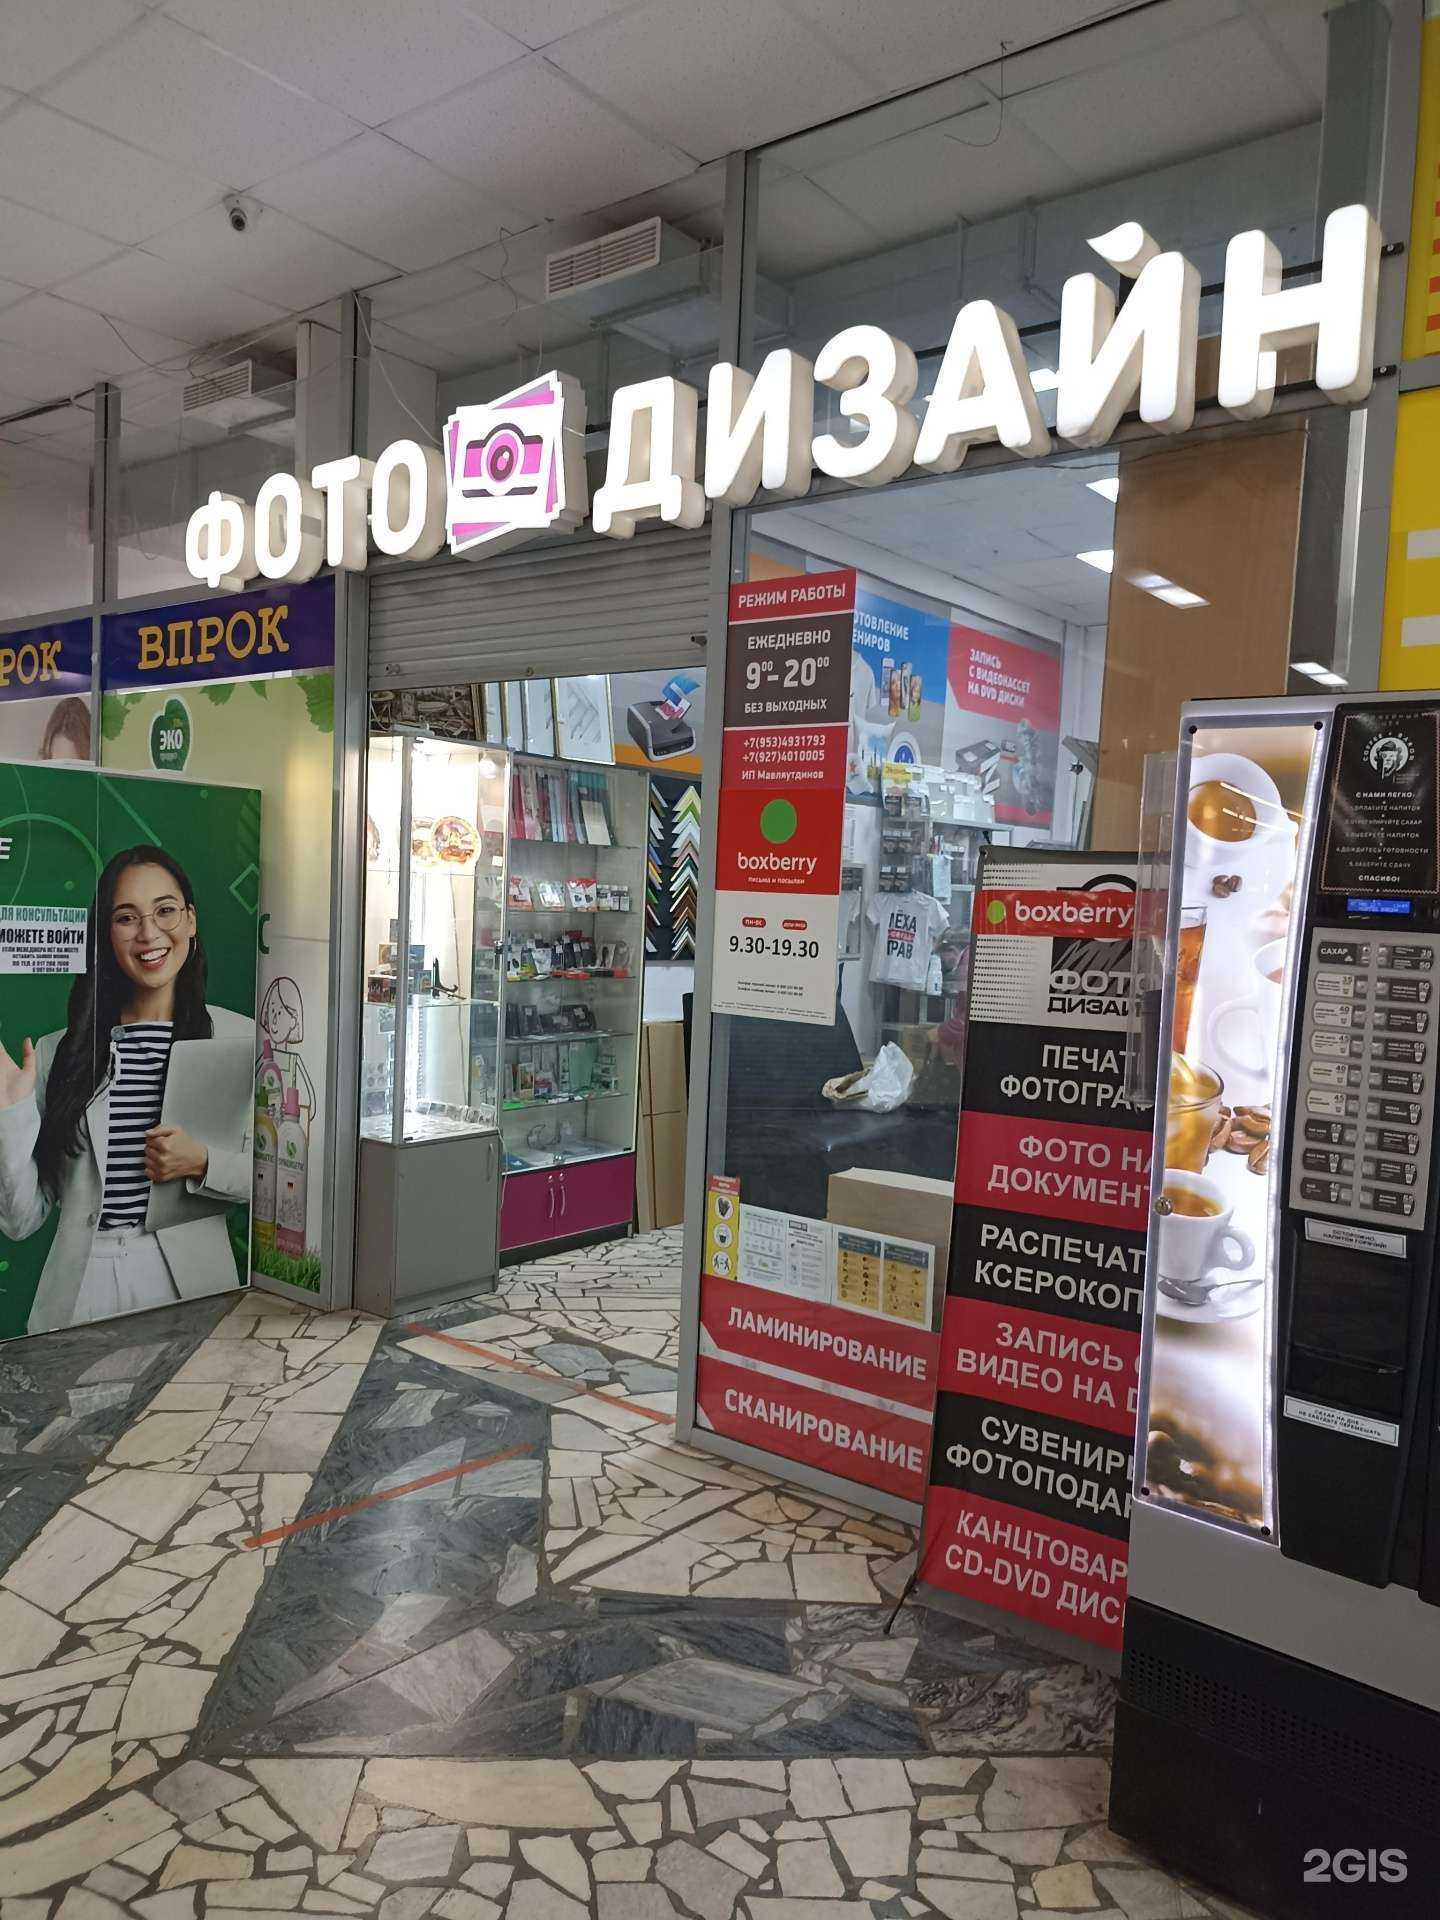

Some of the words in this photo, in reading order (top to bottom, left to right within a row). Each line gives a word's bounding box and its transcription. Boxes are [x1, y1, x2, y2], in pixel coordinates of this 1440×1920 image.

[185, 438, 432, 588] ФОТО
[592, 203, 1376, 536] ДИЗАЙН
[738, 591, 787, 608] РЕЖИМ
[791, 584, 846, 601] РАБОТЫ
[137, 604, 290, 670] ВПРОК
[747, 630, 831, 650] ЕЖЕДНЕВНО
[970, 648, 1002, 669] ЗАПИСЬ
[969, 666, 975, 677] С
[976, 667, 1031, 694] ВИДЕОКАССЕТ
[745, 702, 763, 714] БЕЗ
[766, 699, 828, 713] ВЫХОДНЫХ
[968, 681, 980, 696] НА
[980, 684, 997, 701] DVD
[997, 688, 1025, 708] ДИСКИ
[160, 728, 184, 751] ЭКО
[743, 735, 826, 748] +7(953)4931793
[742, 750, 825, 763] +7(927)4010005
[741, 771, 756, 780] ИП
[737, 852, 817, 875] boxberry
[16, 907, 87, 923] КОНСУЛЬТАЦИИ
[1015, 901, 1135, 928] boxberry
[47, 927, 84, 944] ВОЙТИ
[729, 936, 820, 959] 9.30-19.30
[1000, 1075, 1148, 1112] ФОТОГРА
[1019, 1135, 1111, 1168] ФОТО
[980, 1223, 1145, 1274] РАСПЕЧАТ
[974, 1259, 1144, 1315] КСЕРОКОП
[728, 1307, 927, 1381] ЛАМИНИРОВАНИЕ
[995, 1322, 1124, 1372] ЗАПИСЬ
[956, 1348, 1063, 1394] ВИДЕО
[1072, 1374, 1116, 1409] НА
[725, 1389, 923, 1473] СКАНИРОВАНИЕ
[957, 1509, 1128, 1585] КАНЦТОВАР
[945, 1544, 1051, 1599] CD-DVD
[1056, 1581, 1126, 1628] ДИС
